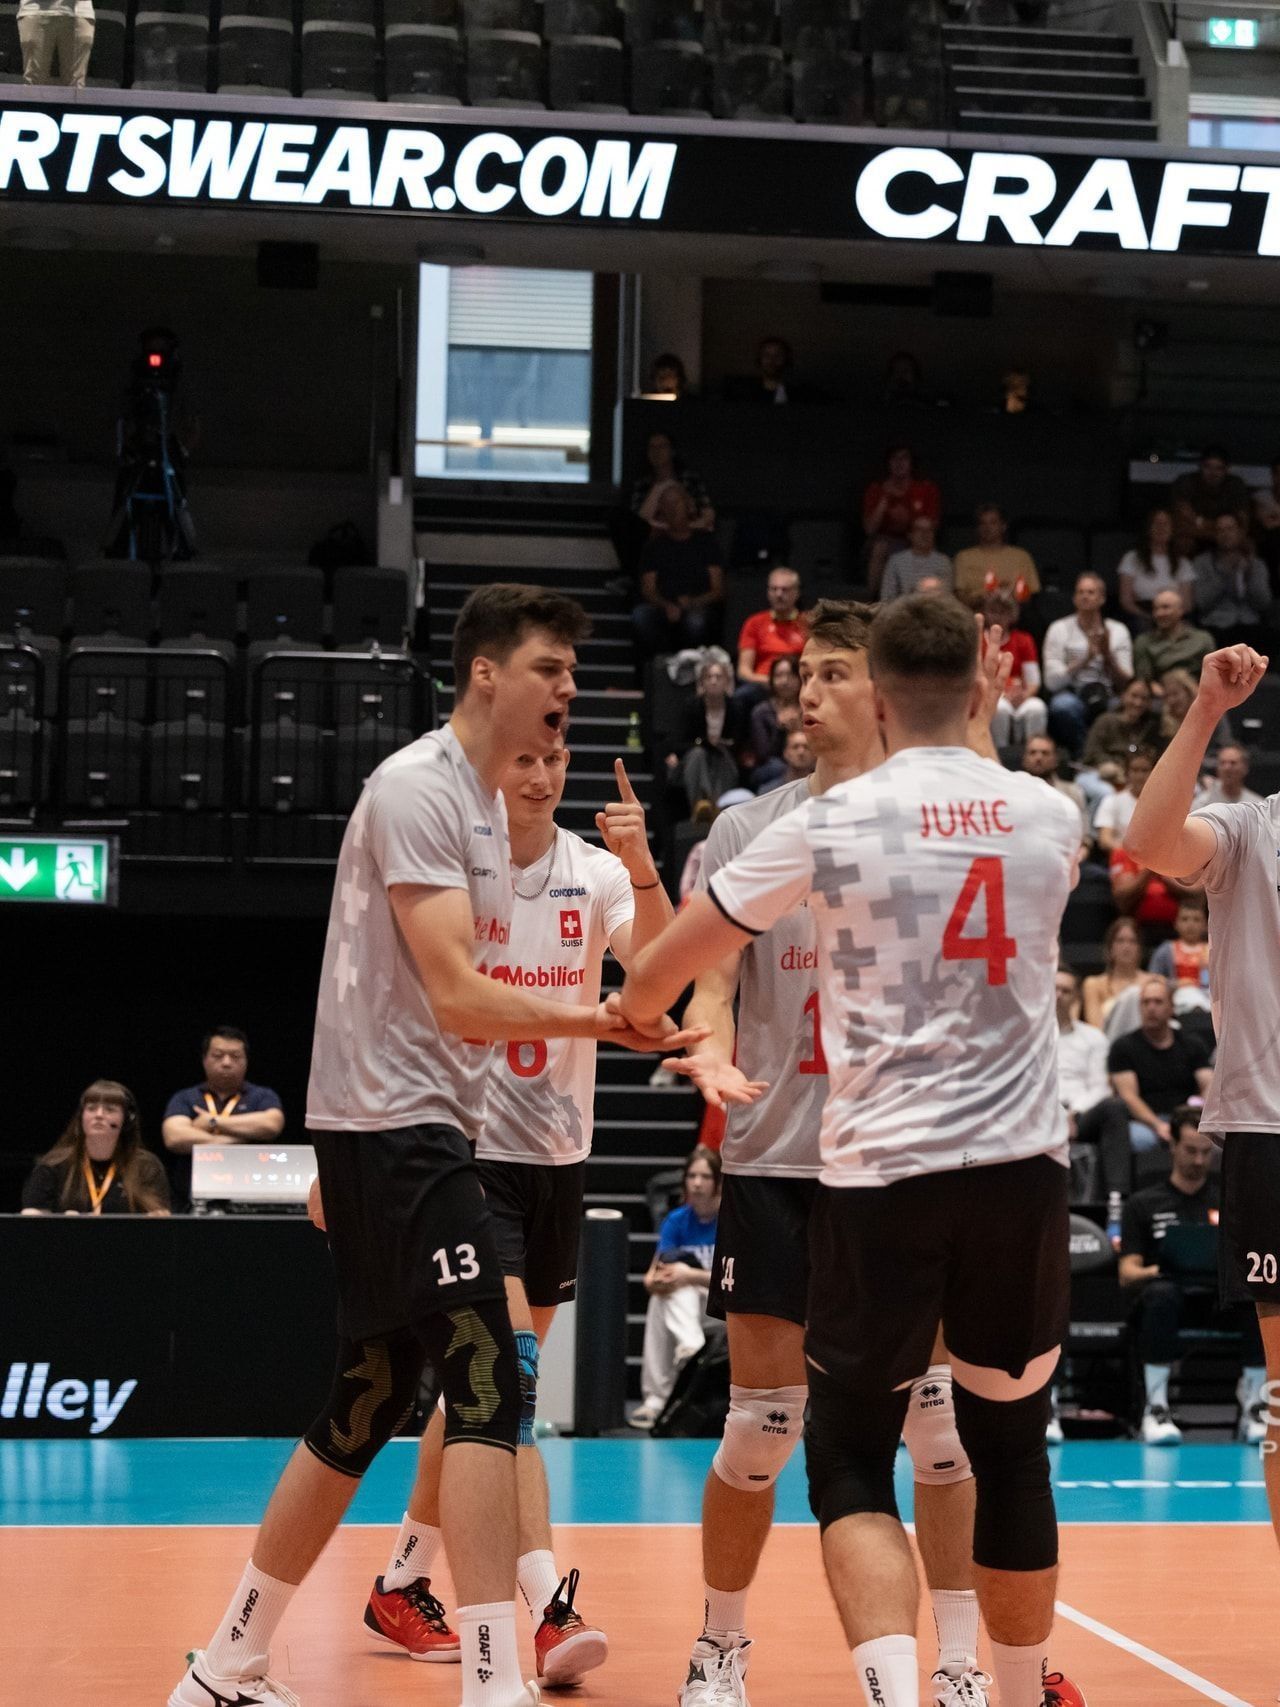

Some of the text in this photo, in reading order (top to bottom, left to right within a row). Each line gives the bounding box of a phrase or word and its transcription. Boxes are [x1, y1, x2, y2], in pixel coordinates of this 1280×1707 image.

[0, 110, 678, 221] RTSWEAR.COM
[920, 799, 1014, 838] JUKIC
[941, 855, 1018, 987] 4
[502, 965, 586, 988] Mobiliar
[431, 1242, 481, 1286] 13
[1246, 1251, 1278, 1285] 20
[0, 1362, 139, 1435] lley
[401, 1534, 419, 1561] CRAFT
[238, 1588, 259, 1627] CRAFT
[478, 1624, 491, 1666] CRAFT
